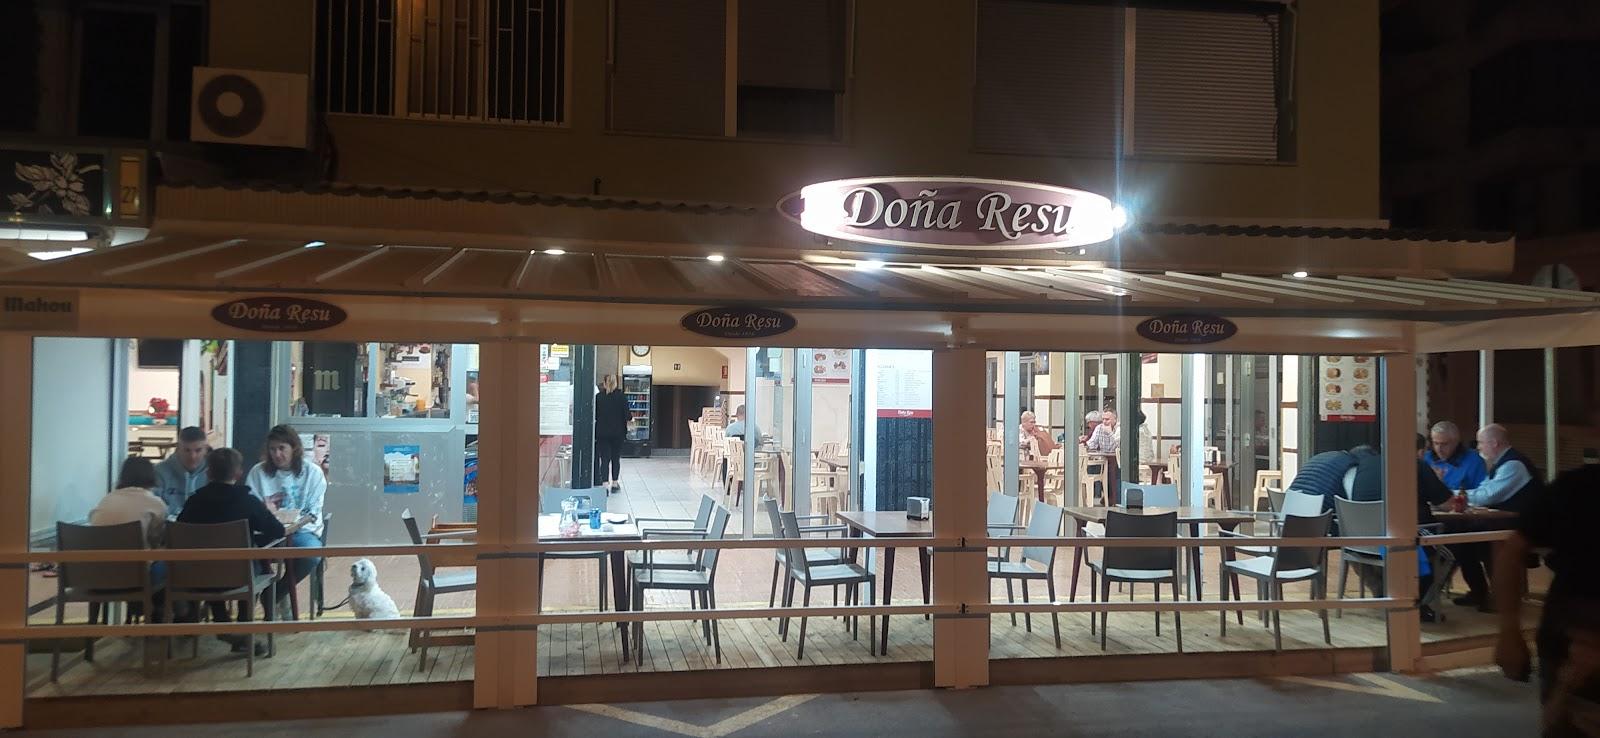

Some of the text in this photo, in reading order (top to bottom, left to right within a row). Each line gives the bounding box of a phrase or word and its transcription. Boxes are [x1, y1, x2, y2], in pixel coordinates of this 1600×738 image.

[842, 186, 963, 230] Doña
[4, 296, 72, 313] Mahou
[228, 302, 331, 325] Doña Resu
[696, 312, 782, 332] Doña Resu
[1149, 319, 1225, 337] Doña Resu
